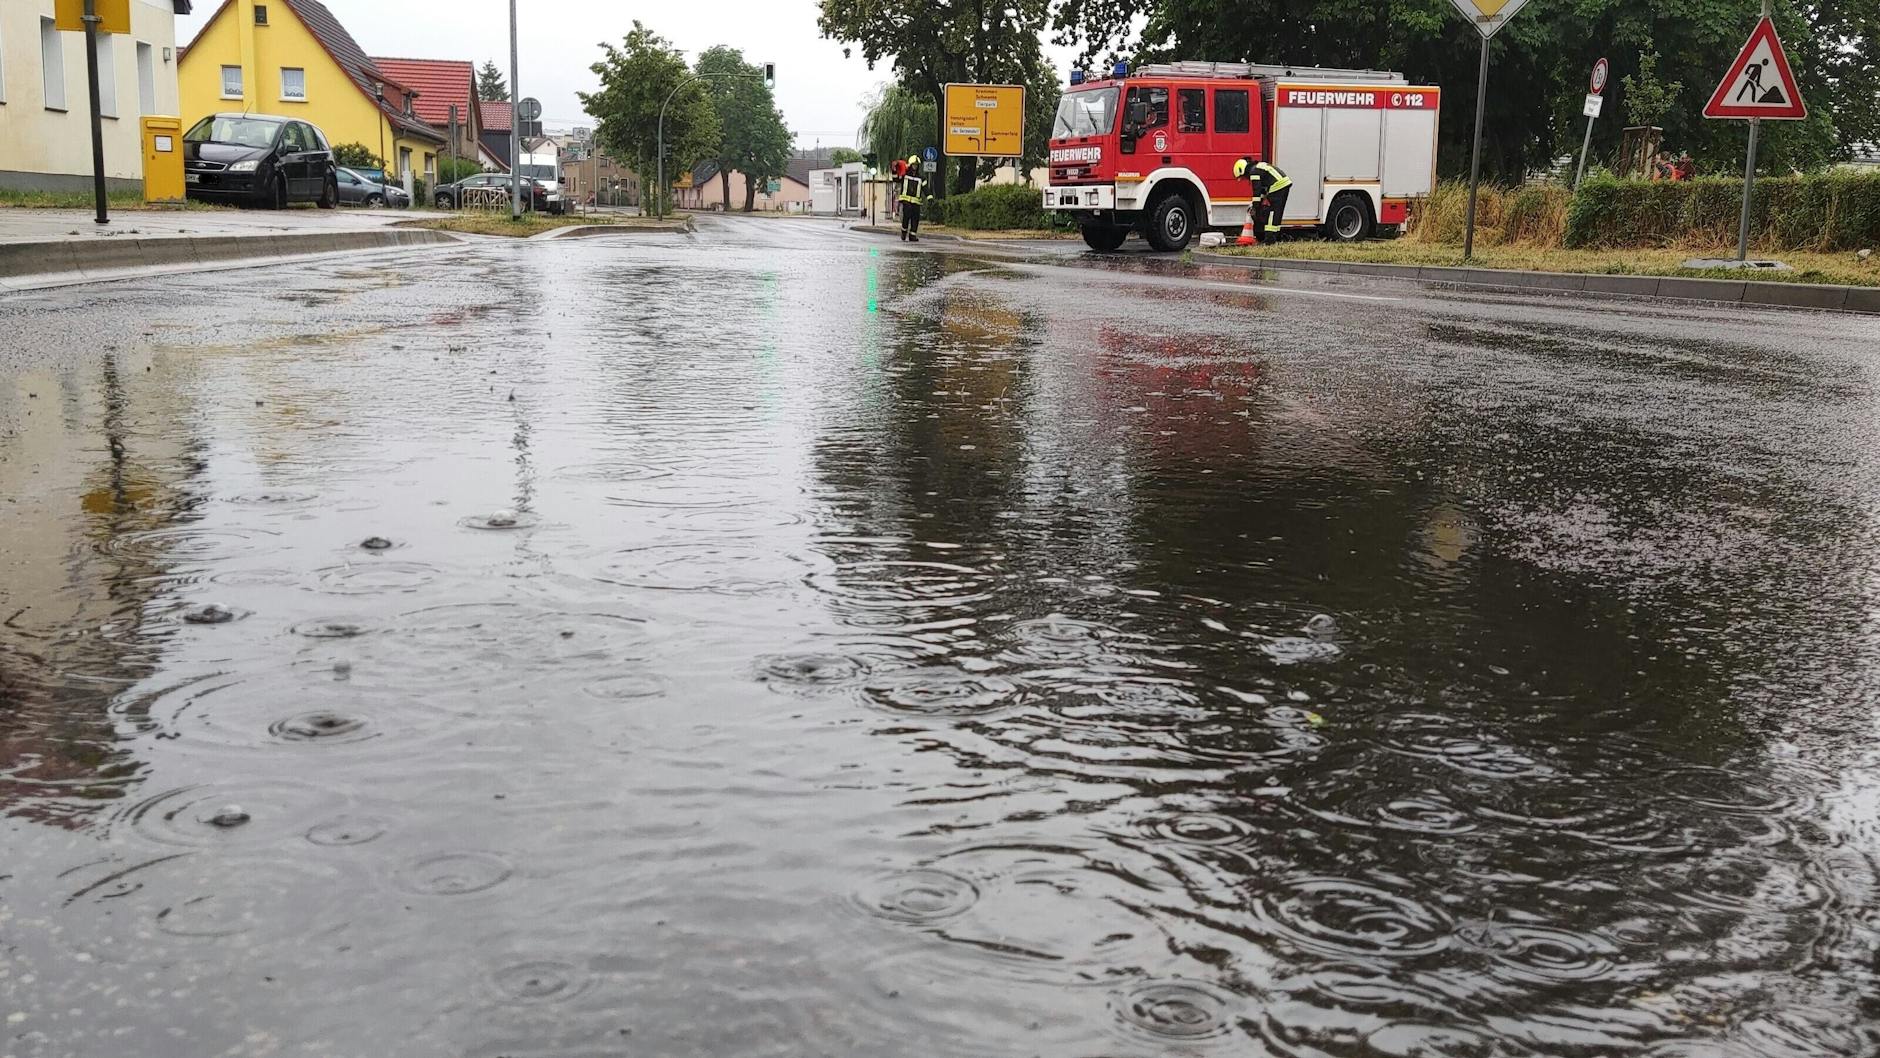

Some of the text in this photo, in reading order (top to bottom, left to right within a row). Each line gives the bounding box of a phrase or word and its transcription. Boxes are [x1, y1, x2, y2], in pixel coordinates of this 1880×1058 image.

[1288, 91, 1423, 106] FEUERWEHR 112
[1050, 147, 1102, 162] FEUERWEHR
